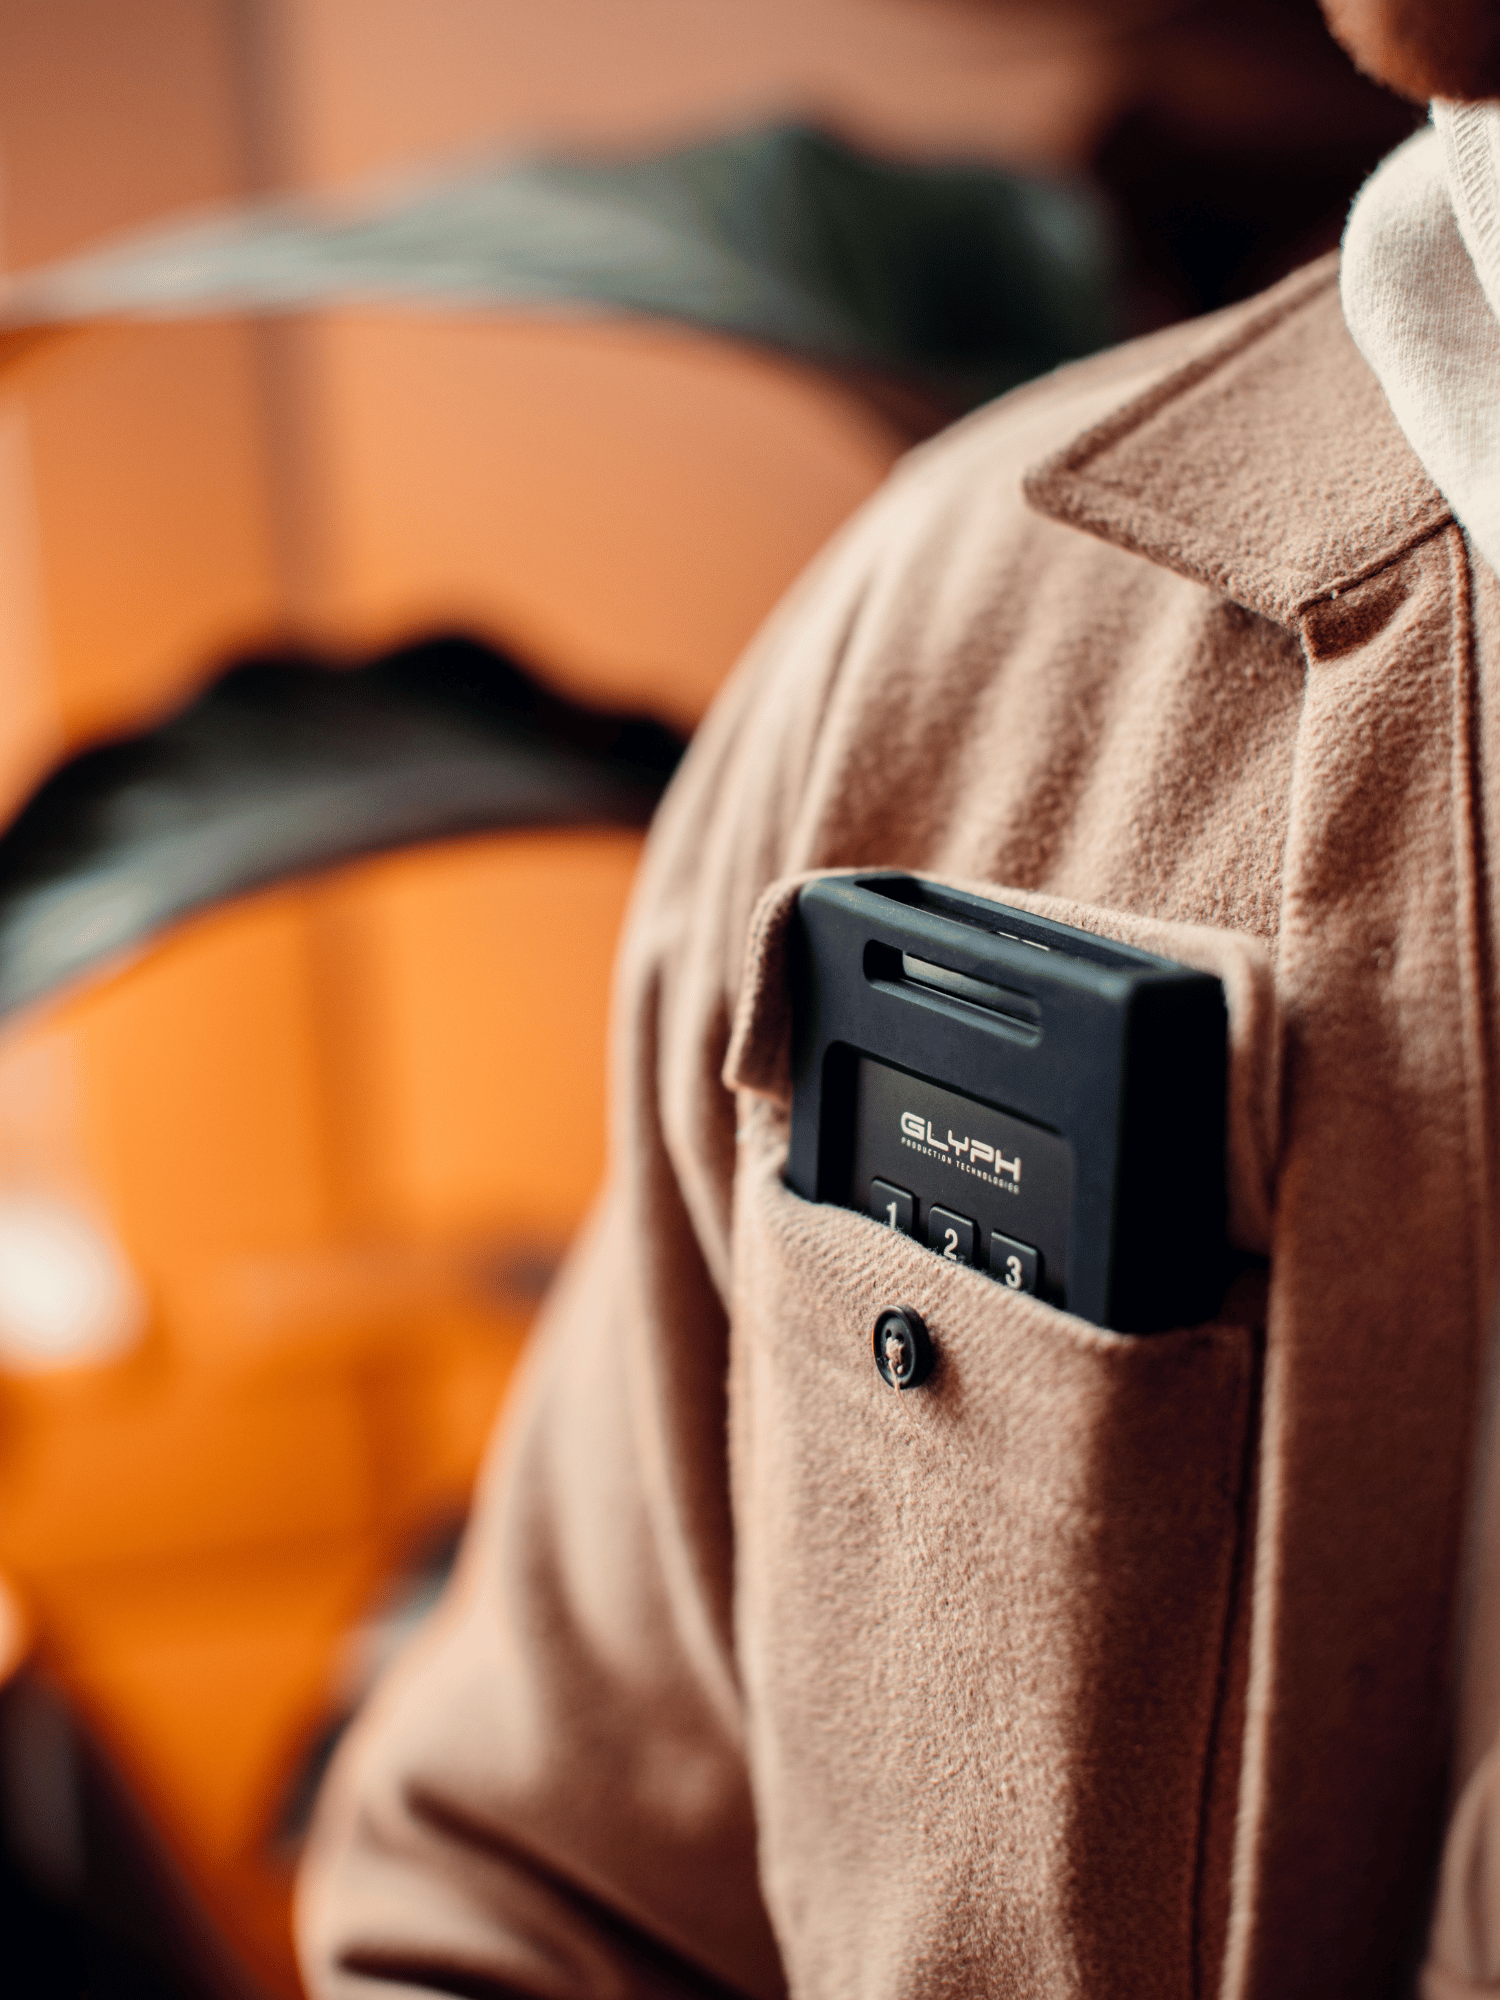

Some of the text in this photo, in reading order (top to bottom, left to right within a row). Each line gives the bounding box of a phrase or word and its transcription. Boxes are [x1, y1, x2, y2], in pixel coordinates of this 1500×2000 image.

[901, 1111, 1021, 1182] GLYPH
[901, 1136, 1019, 1195] PRODUCTION TECHNOLOGIES
[886, 1201, 1022, 1289] 1 2 3
